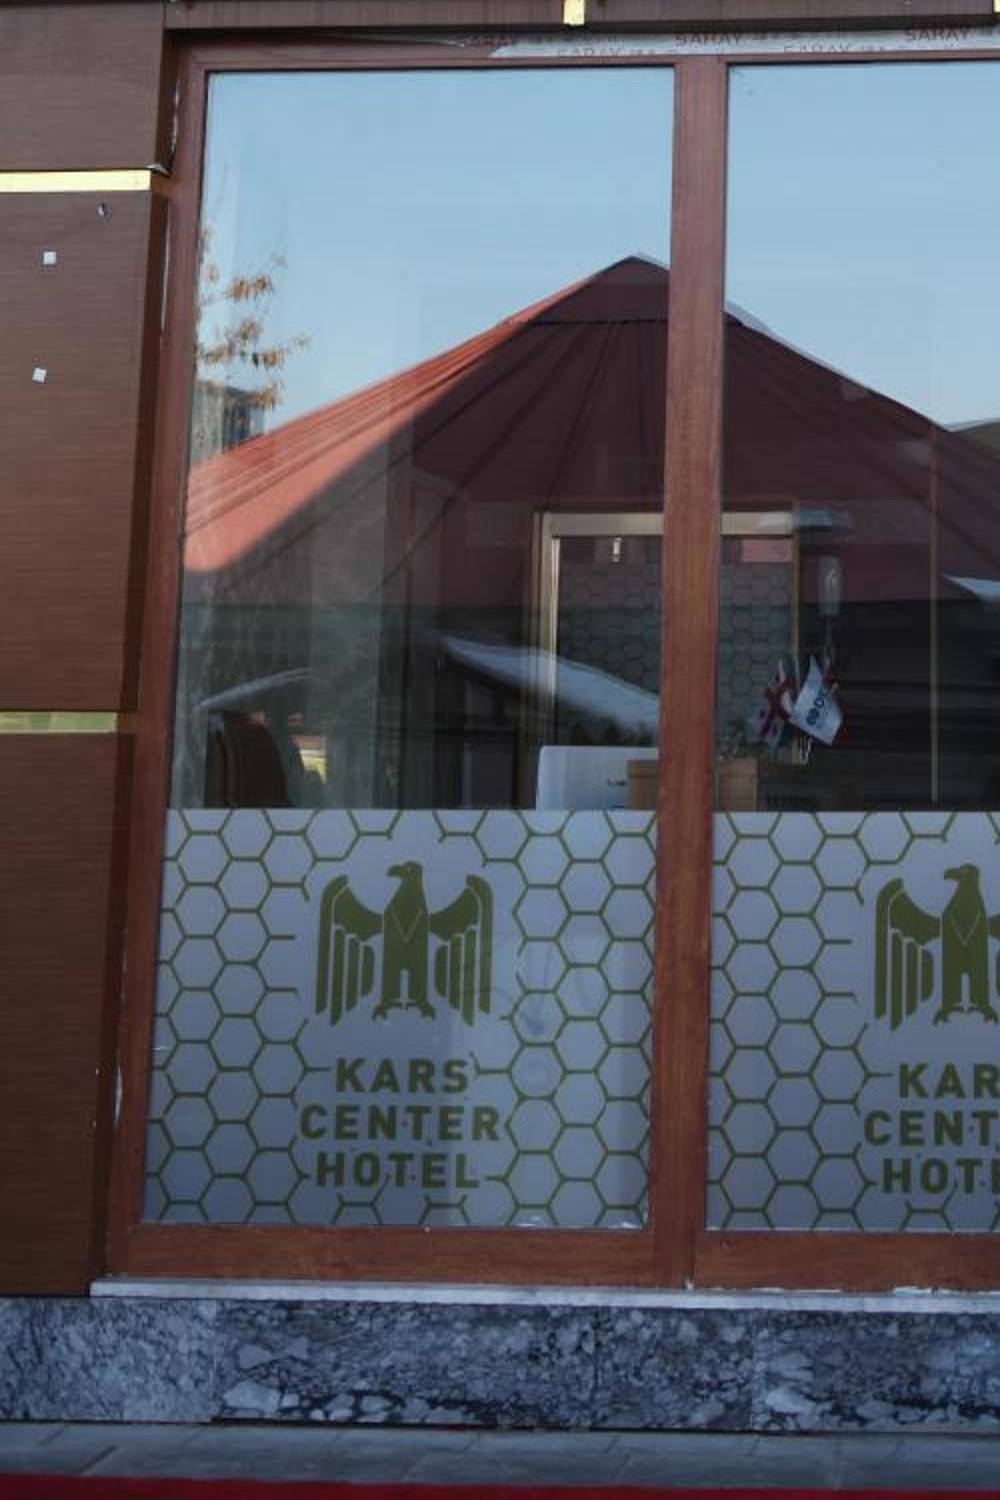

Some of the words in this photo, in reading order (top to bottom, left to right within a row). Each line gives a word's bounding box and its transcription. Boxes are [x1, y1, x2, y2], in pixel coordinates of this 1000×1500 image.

[335, 1058, 469, 1093] KARS
[300, 1105, 500, 1141] CENTER
[316, 1152, 480, 1188] HOTEL
